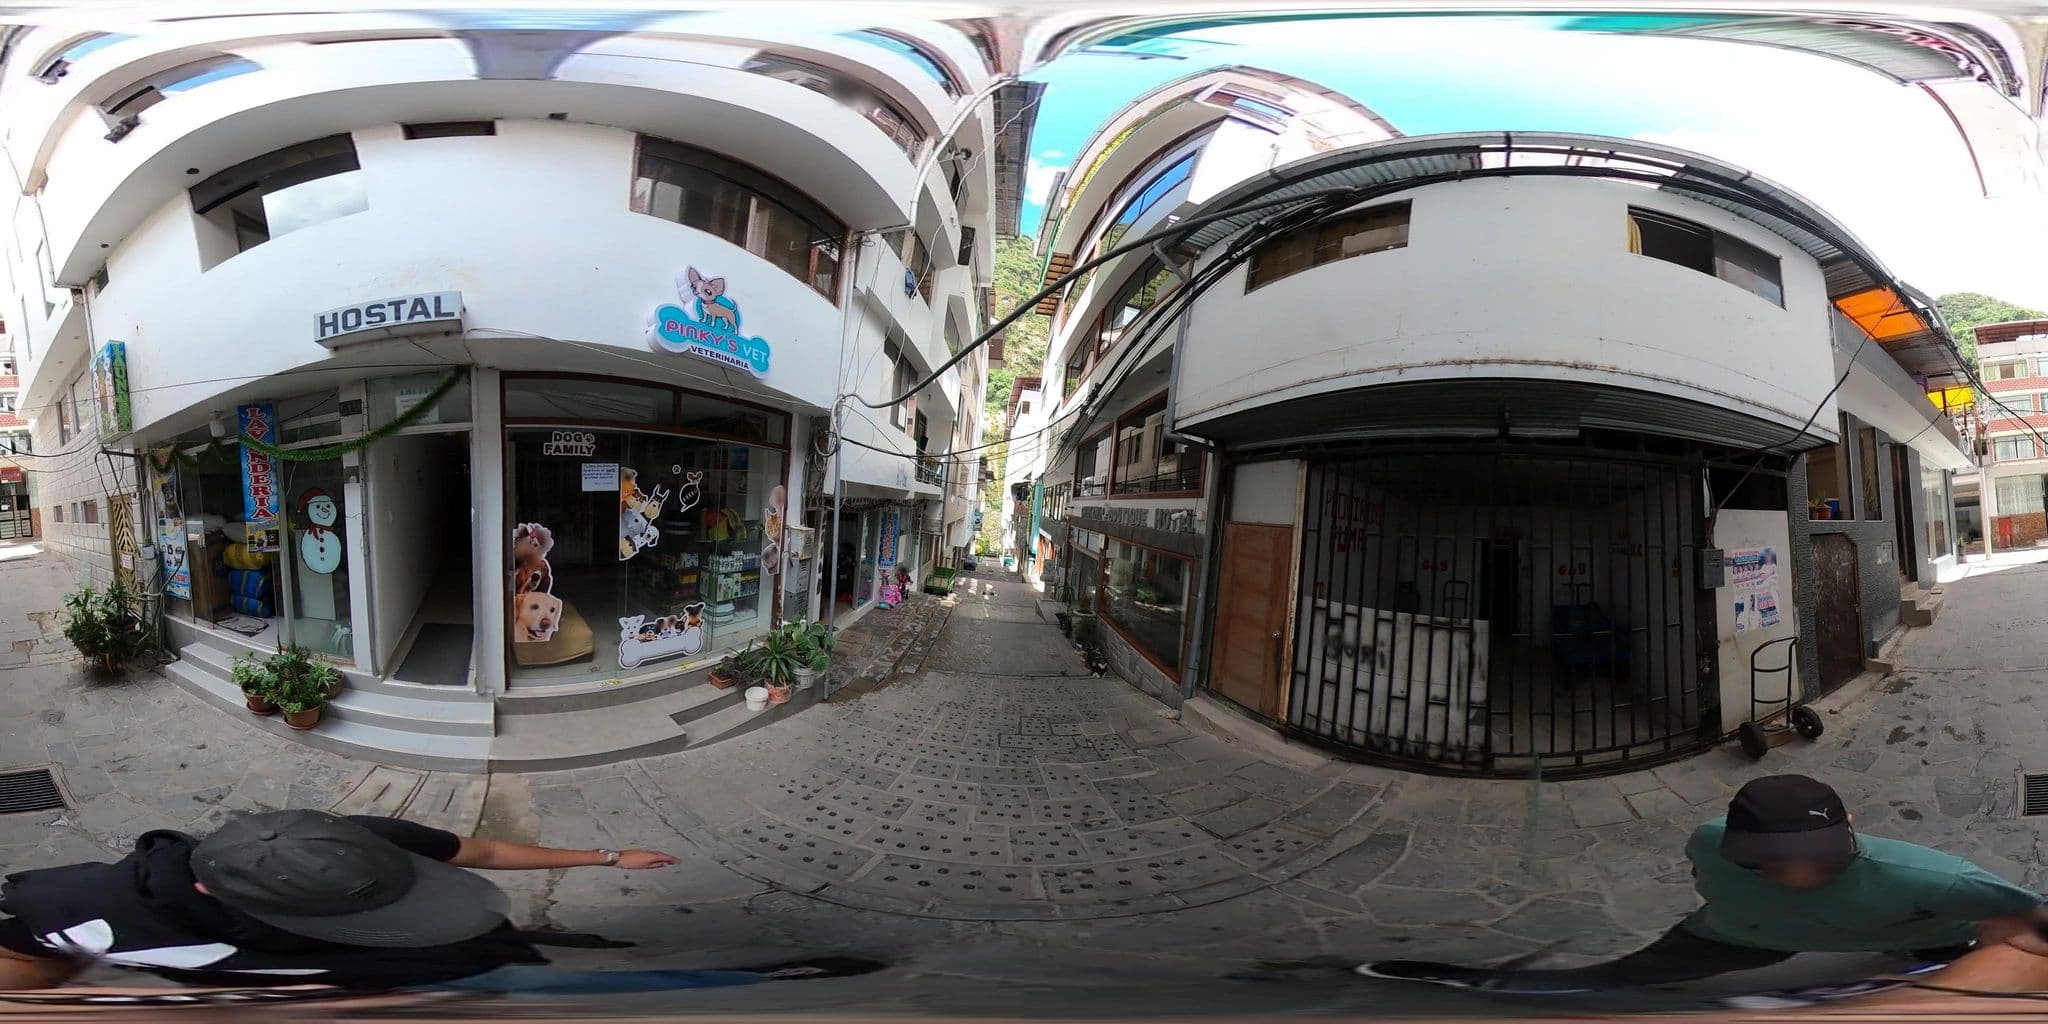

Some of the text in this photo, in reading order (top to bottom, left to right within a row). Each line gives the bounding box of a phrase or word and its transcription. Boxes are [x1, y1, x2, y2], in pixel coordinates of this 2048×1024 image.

[319, 295, 455, 337] HOSTAL
[665, 320, 768, 363] PINKY'S VET
[690, 345, 750, 369] VETERINARIA
[543, 442, 596, 456] FAMILY
[552, 431, 584, 444] DOG
[245, 407, 274, 519] LAVNDERIA
